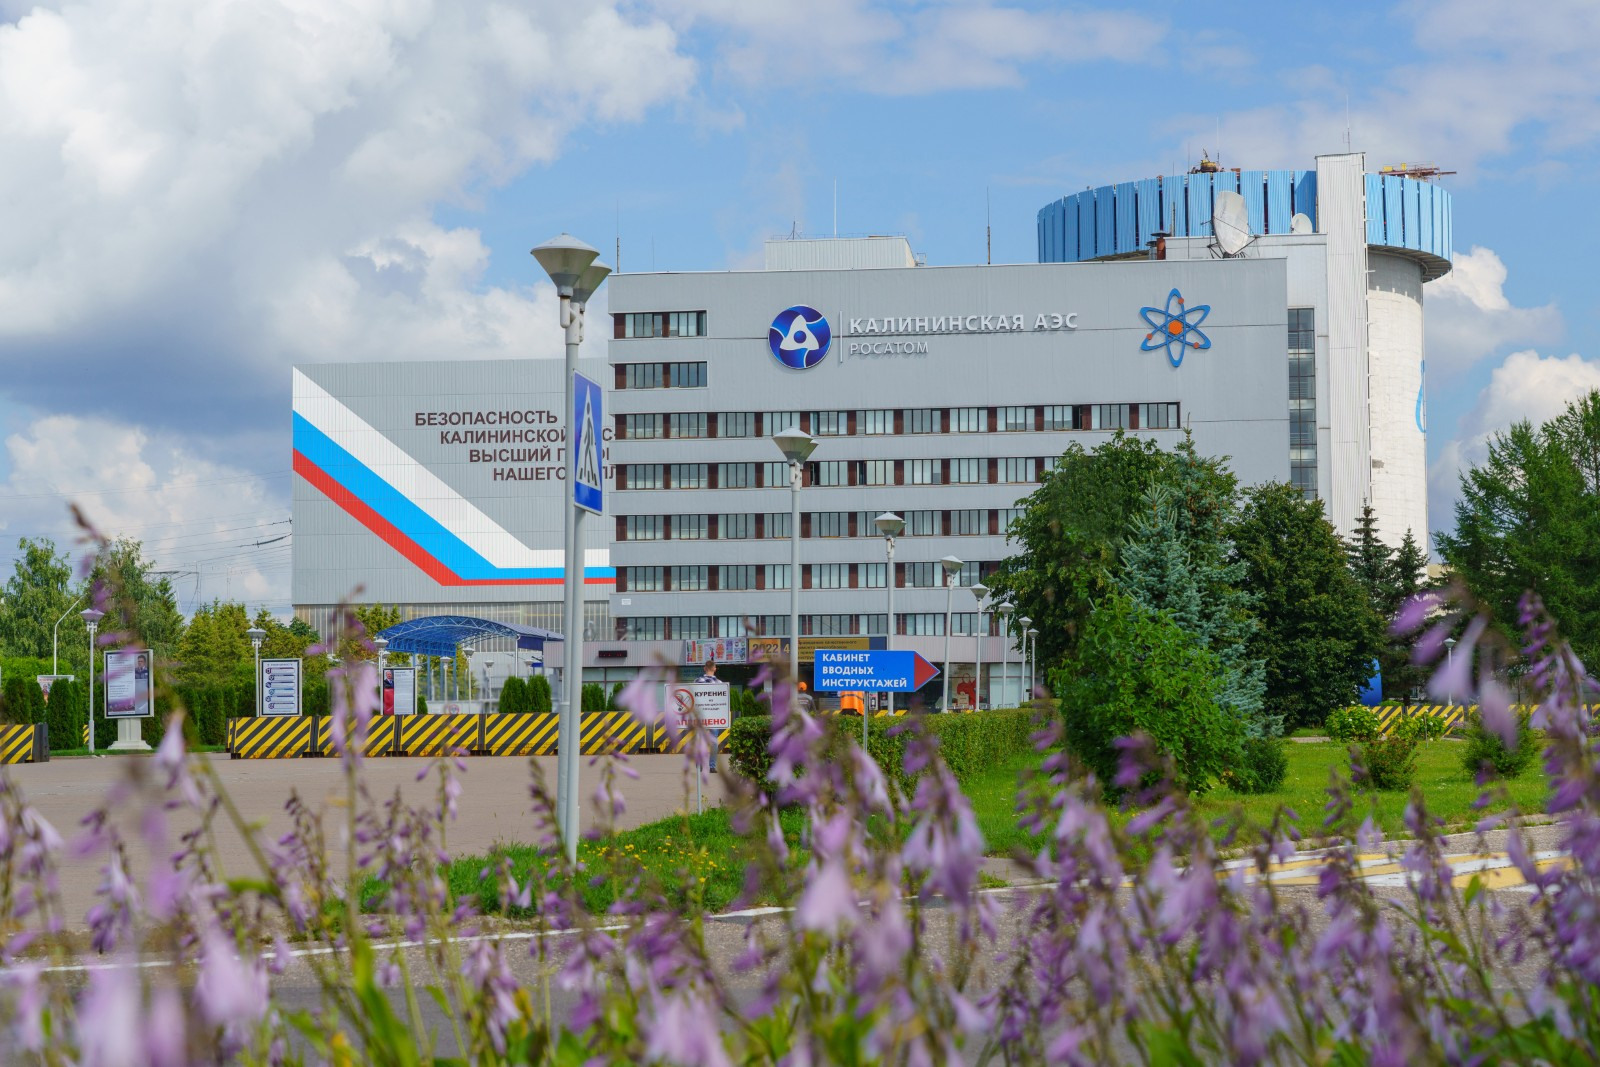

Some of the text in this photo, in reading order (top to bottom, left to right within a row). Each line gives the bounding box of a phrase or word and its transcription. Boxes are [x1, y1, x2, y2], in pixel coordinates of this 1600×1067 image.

[850, 312, 1078, 334] КАЛИНИНСКАЯ АЭС
[850, 341, 929, 355] РОСАТОМ
[415, 410, 558, 426] БЕЗОПАСНОСТЬ
[469, 445, 550, 463] ВЫСШИЙ
[822, 653, 871, 662] КАБИНЕТ
[822, 666, 874, 675] ВВОДНЫХ
[822, 677, 907, 688] ИНСТРУКТАЖЕЙ
